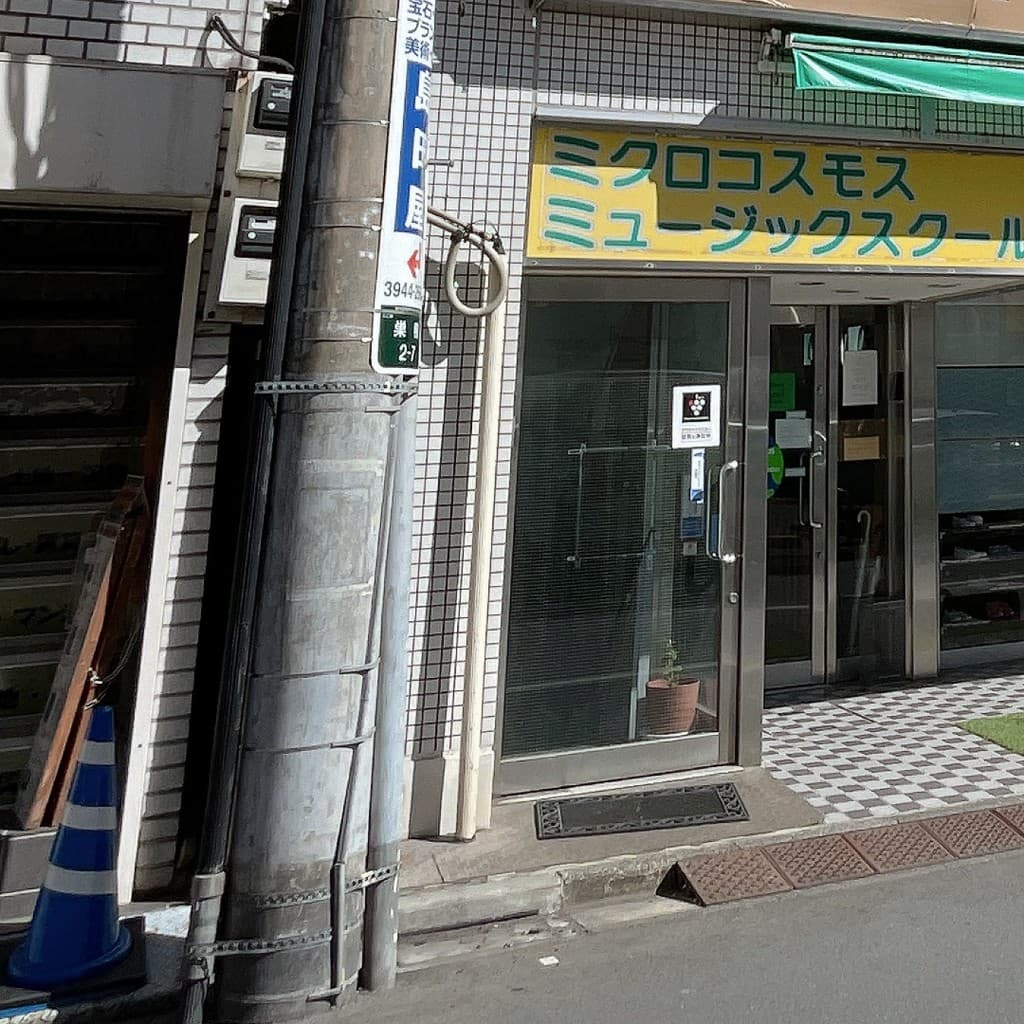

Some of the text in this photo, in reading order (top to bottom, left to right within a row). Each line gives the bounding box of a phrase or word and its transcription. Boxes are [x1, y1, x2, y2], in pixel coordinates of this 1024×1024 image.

[550, 134, 914, 201] ミクロコスモス
